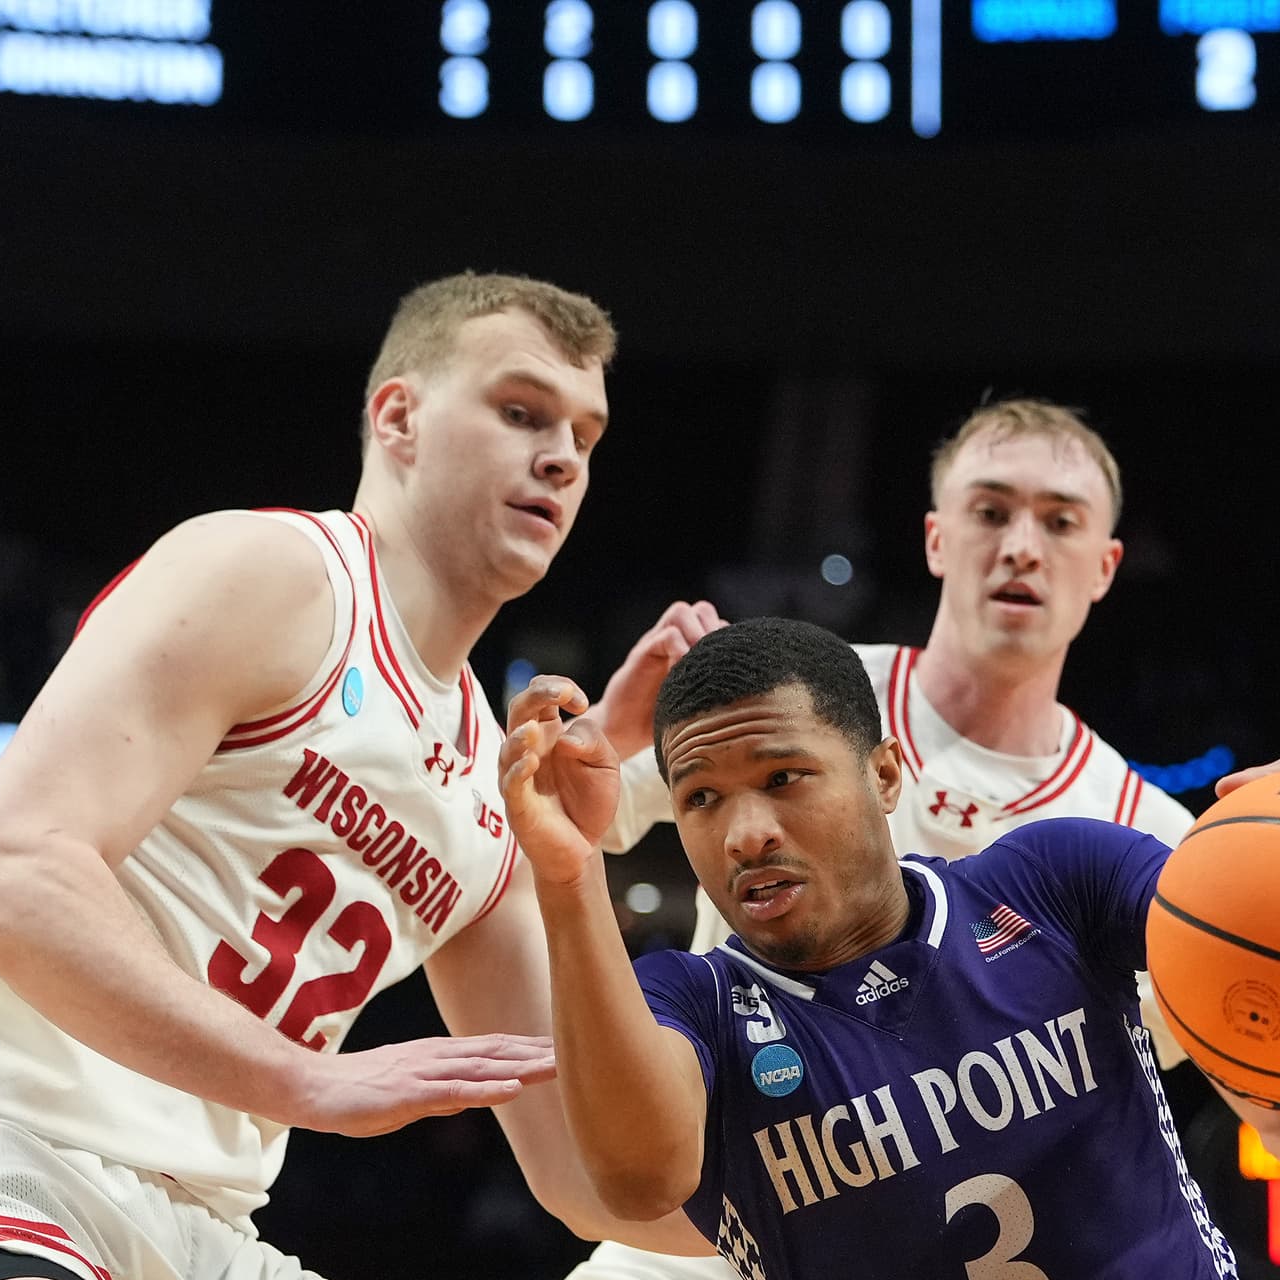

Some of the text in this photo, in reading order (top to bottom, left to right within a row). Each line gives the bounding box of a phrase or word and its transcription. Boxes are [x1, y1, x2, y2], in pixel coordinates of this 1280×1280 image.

[282, 747, 463, 936] WISCONSIN
[206, 847, 393, 1053] 32
[855, 977, 910, 1006] adidas
[752, 1083, 922, 1215] HIGH
[910, 1007, 1100, 1155] POINT
[760, 1065, 801, 1087] NCAA
